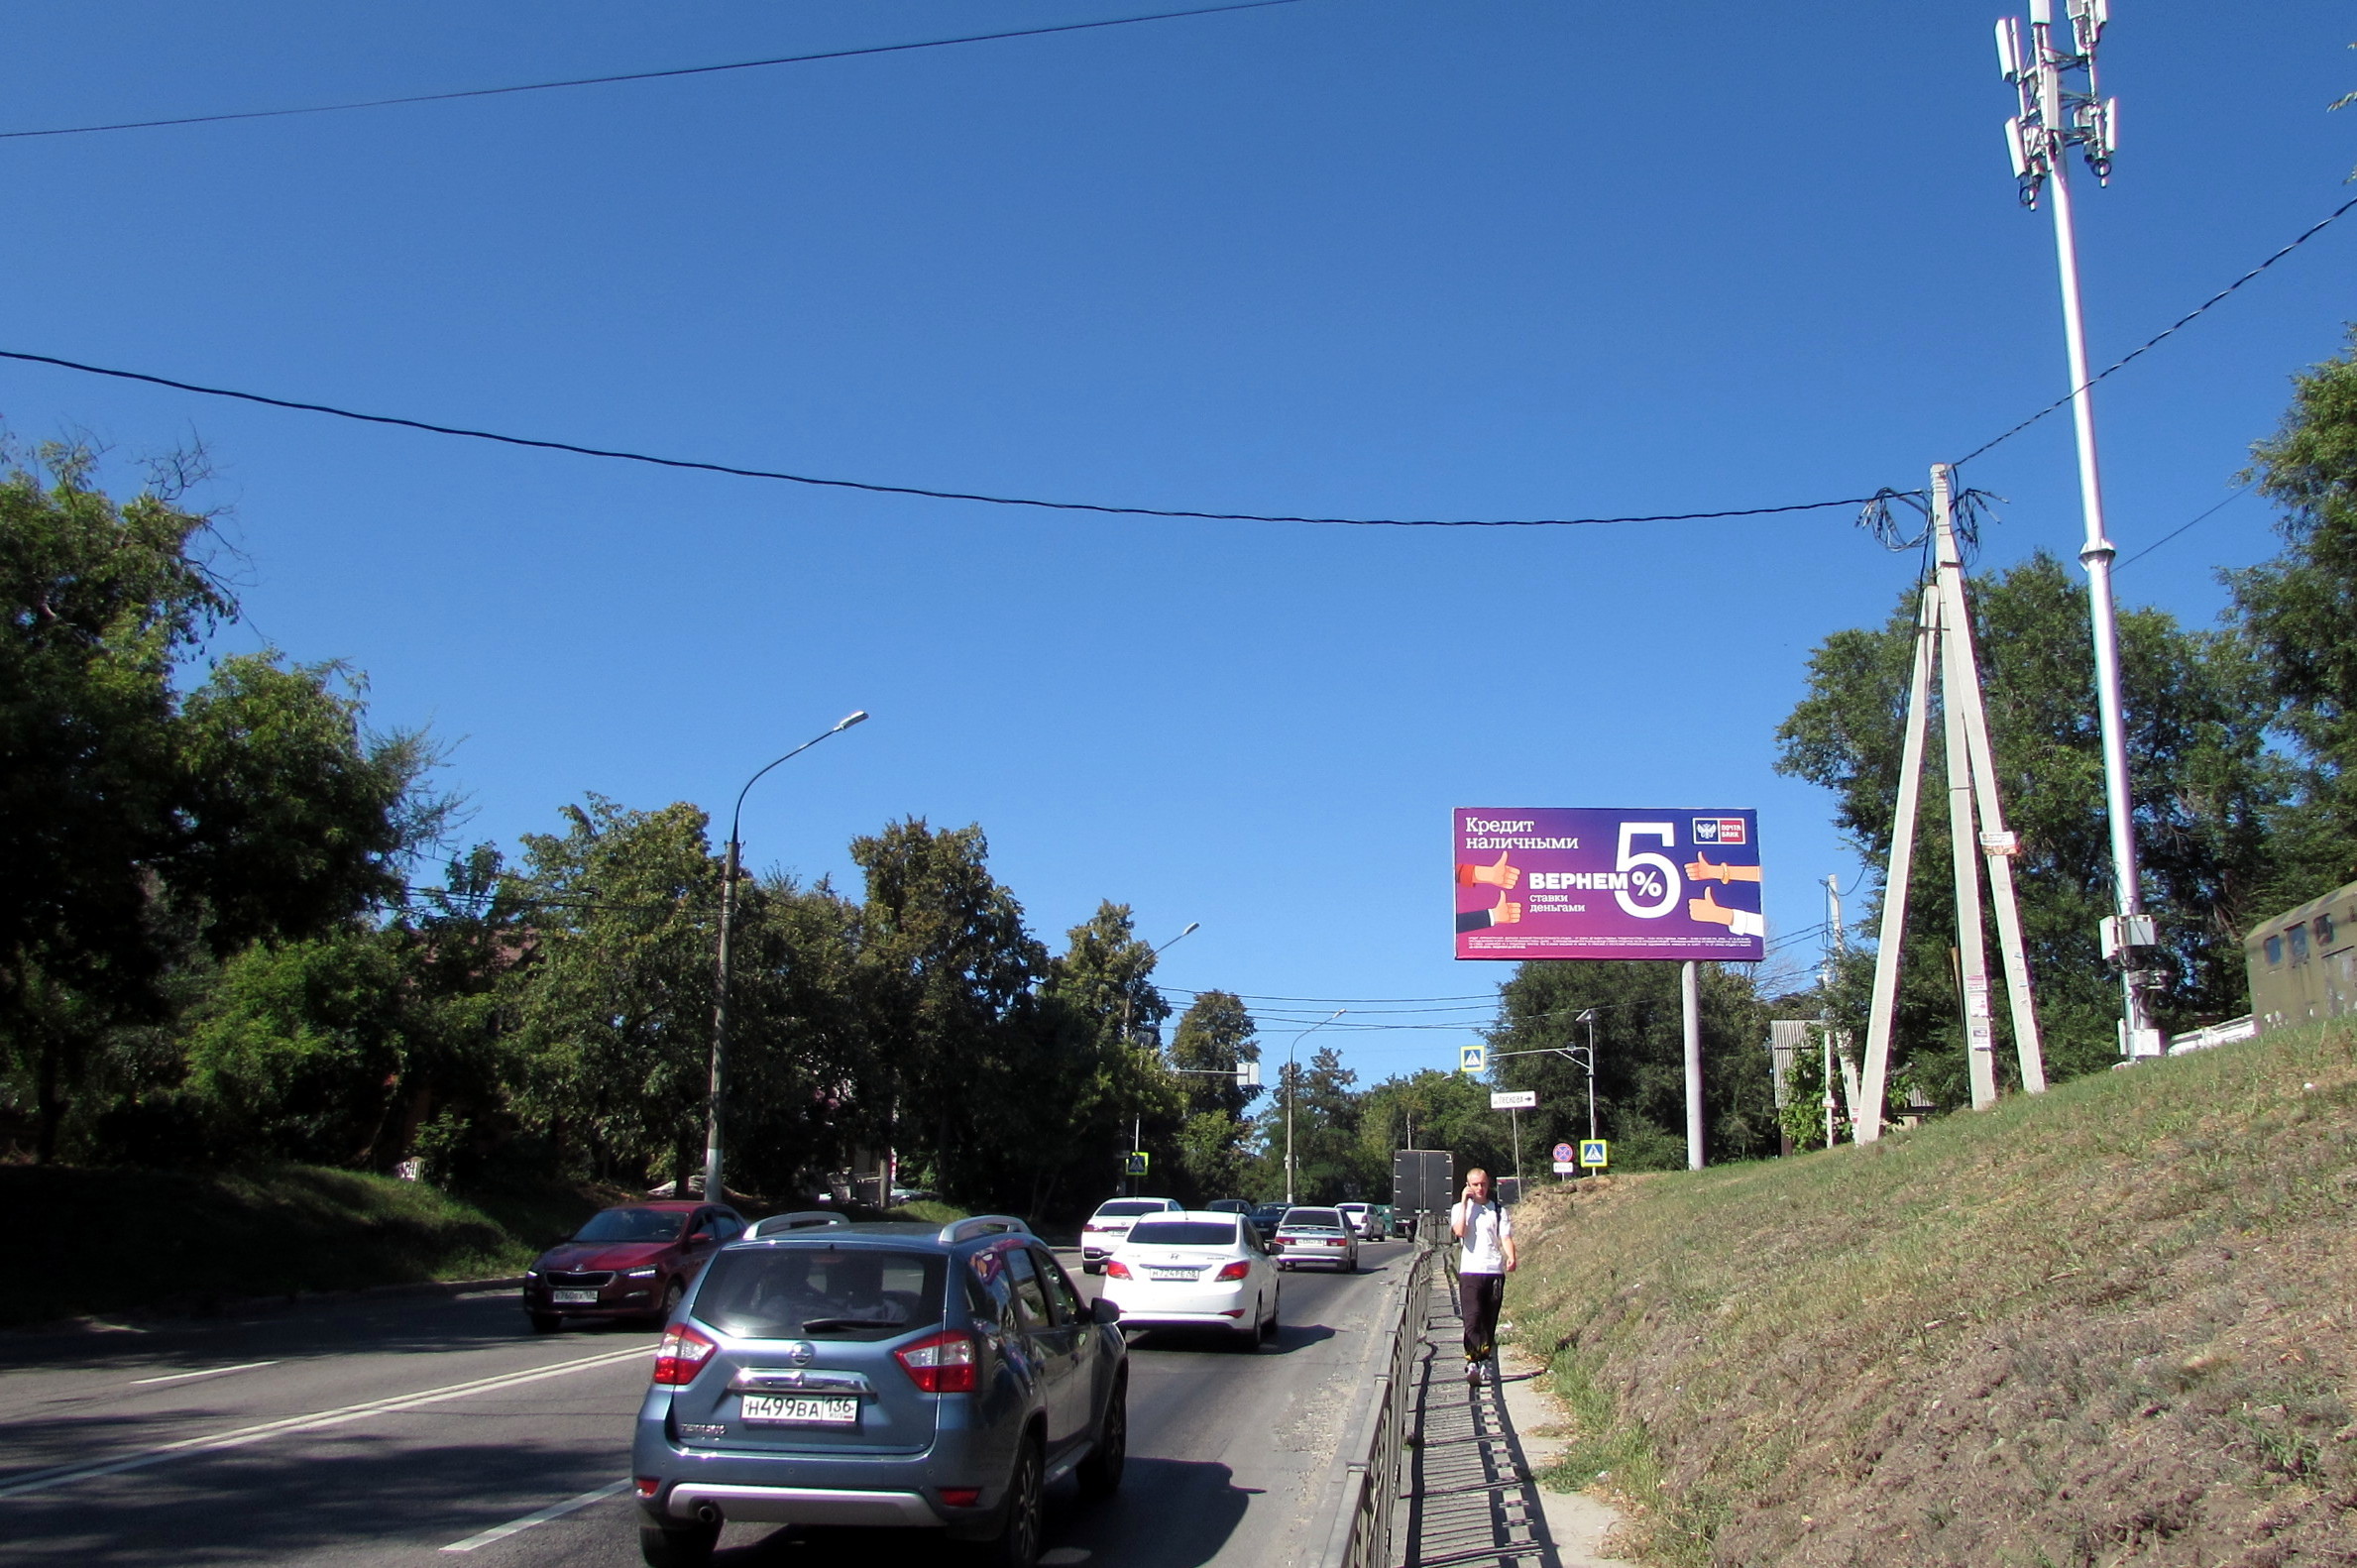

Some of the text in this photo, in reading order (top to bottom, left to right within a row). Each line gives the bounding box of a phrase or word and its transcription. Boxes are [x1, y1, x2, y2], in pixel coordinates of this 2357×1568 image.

[1465, 817, 1535, 835] Кредит
[1465, 837, 1579, 849] наличными
[1528, 872, 1628, 890] ВЕРНЕМ
[1529, 894, 1568, 903] ставки
[1529, 903, 1585, 913] деньгами
[825, 1398, 851, 1413] 136
